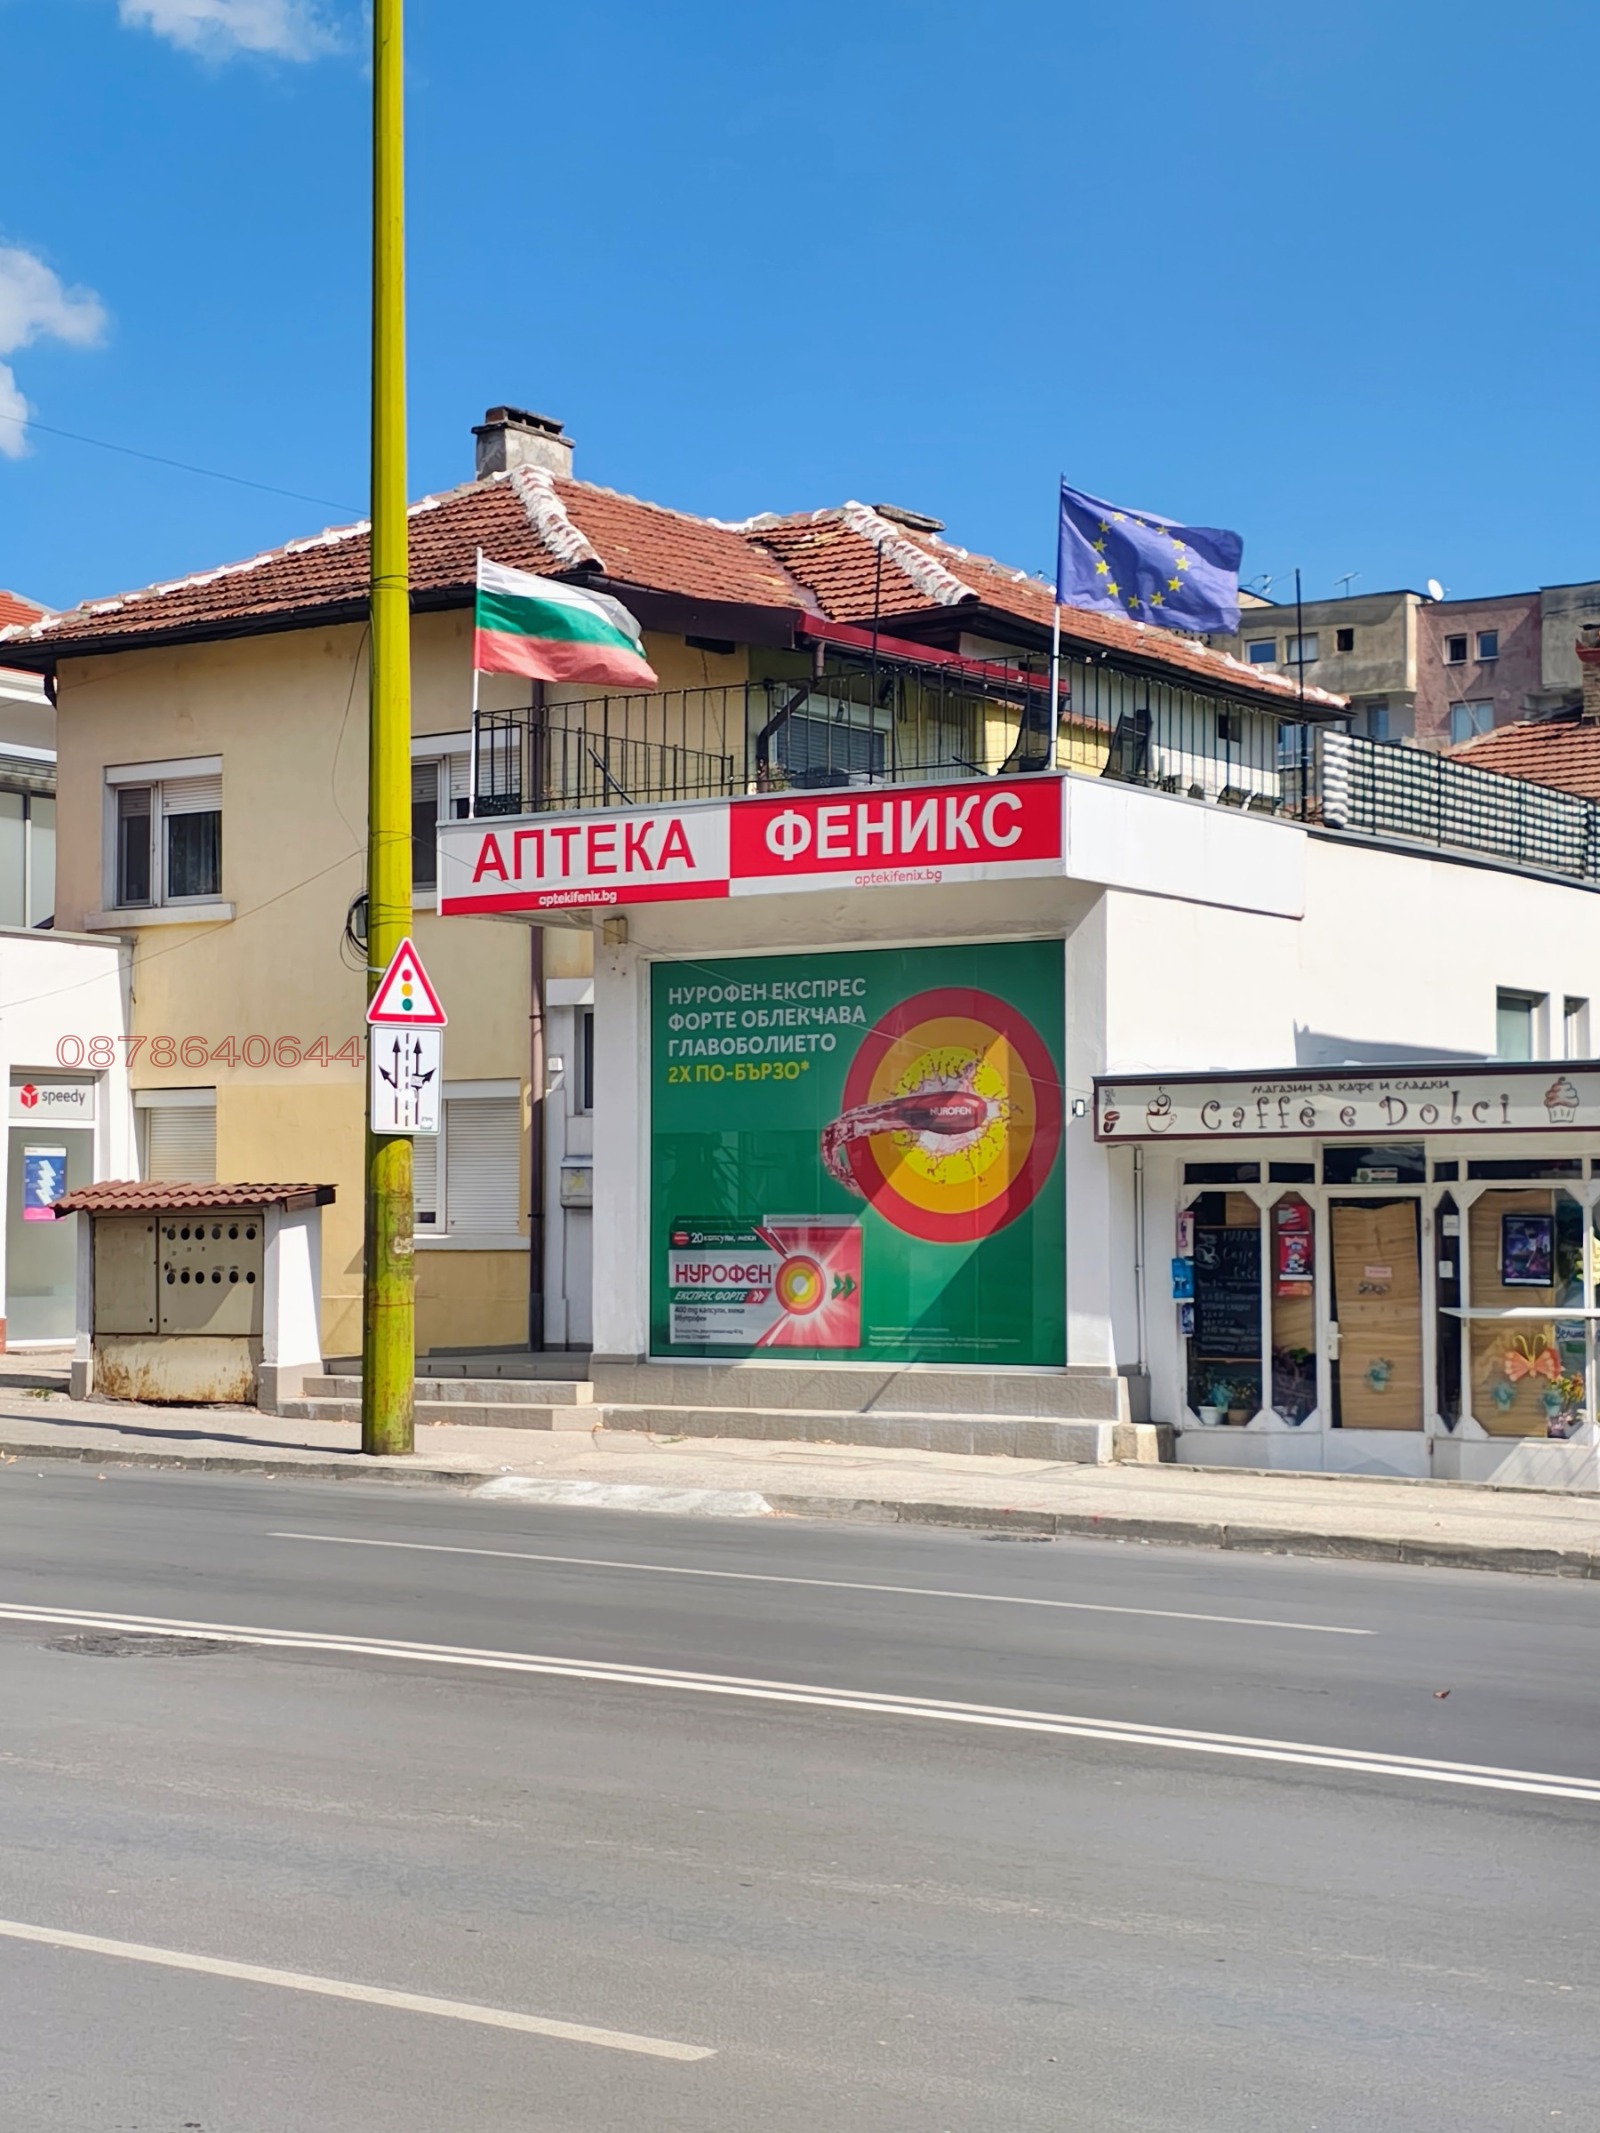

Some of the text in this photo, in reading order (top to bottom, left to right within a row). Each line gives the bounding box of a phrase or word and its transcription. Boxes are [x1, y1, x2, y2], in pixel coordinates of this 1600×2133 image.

[765, 792, 1023, 861] ФЕНИКС
[472, 819, 696, 883] АПТЕКА
[855, 869, 942, 887] aptekifenix.bg
[538, 890, 617, 906] aptekifenix.bg
[668, 978, 866, 1005] НУРОФЕН ЕКСПРЕС
[668, 1005, 867, 1031] ФОРТЕ ОБЛЕКЧАВА
[668, 1033, 836, 1057] ГЛАВОБОЛИЕТО
[41, 1088, 86, 1106] speedy
[930, 1106, 972, 1116] NUROFEN
[1201, 1090, 1512, 1130] Caffè e Dolci
[691, 1232, 704, 1244] 20
[675, 1264, 772, 1284] НУРОФЕН
[674, 1291, 748, 1301] ЕКСПРЕС ФОРТЕ
